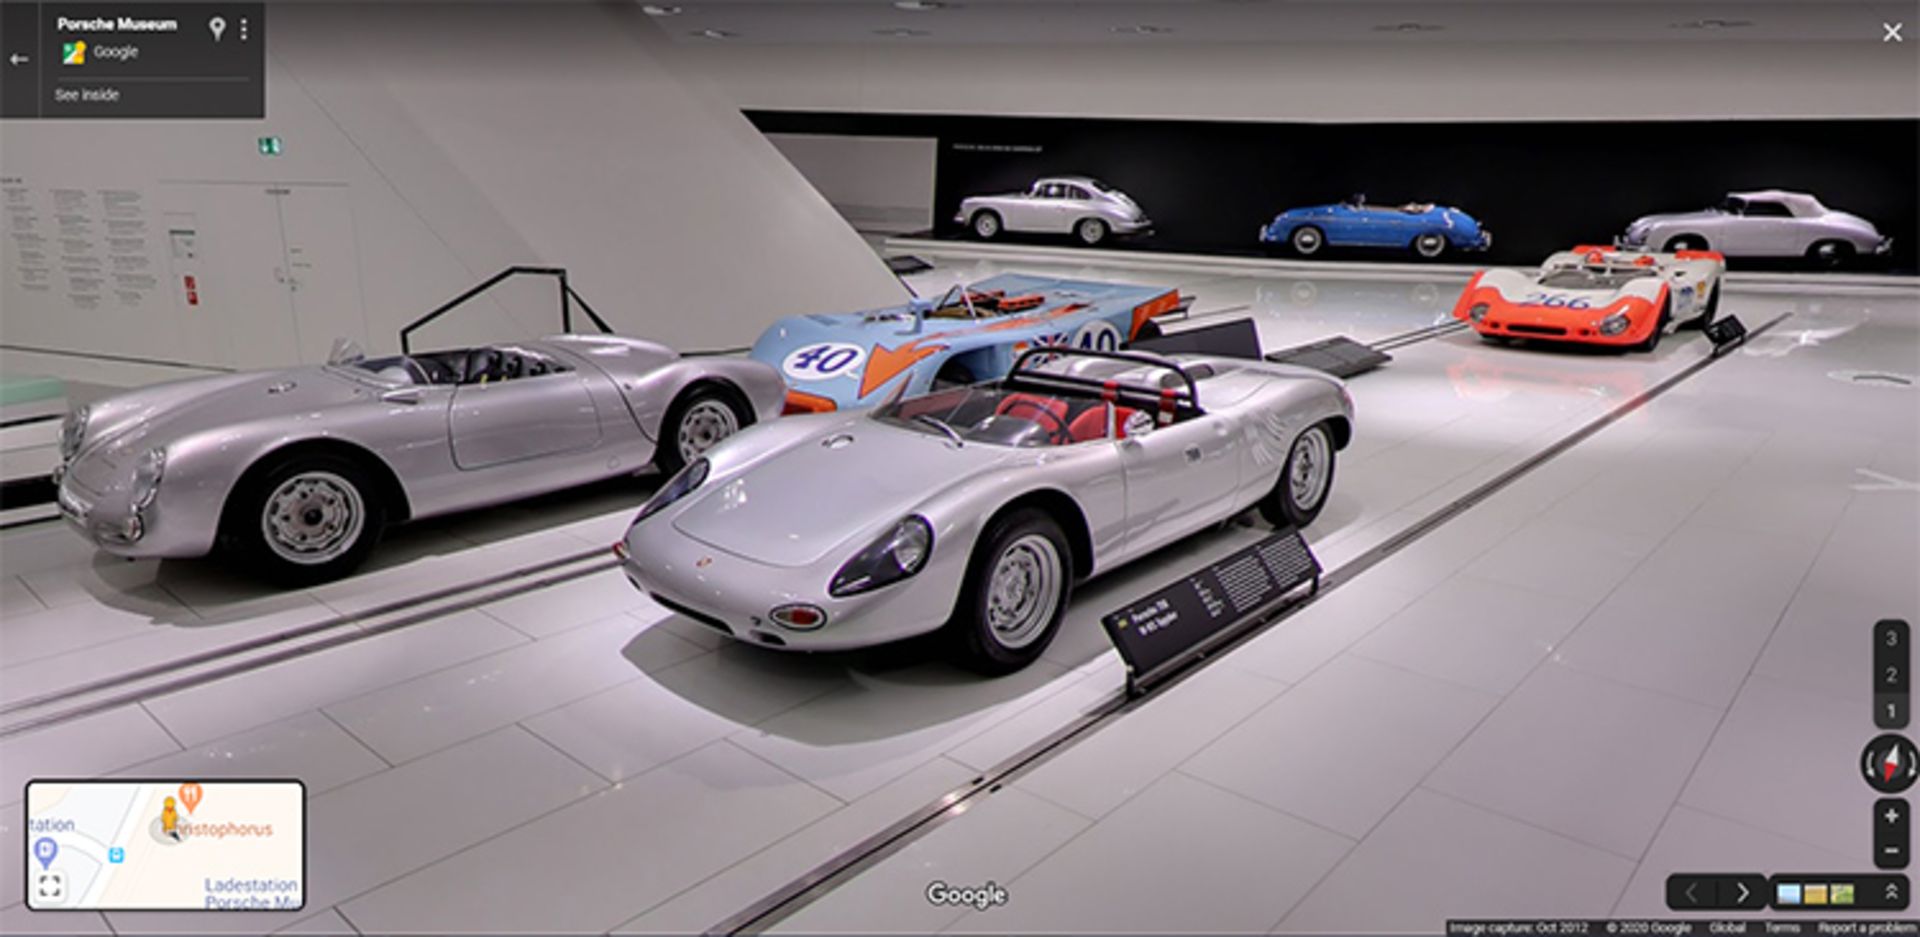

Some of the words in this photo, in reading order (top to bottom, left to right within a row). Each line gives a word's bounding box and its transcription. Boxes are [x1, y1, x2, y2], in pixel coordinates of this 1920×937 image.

[1519, 293, 1590, 310] 266
[1080, 328, 1117, 351] 40
[793, 345, 859, 374] 40
